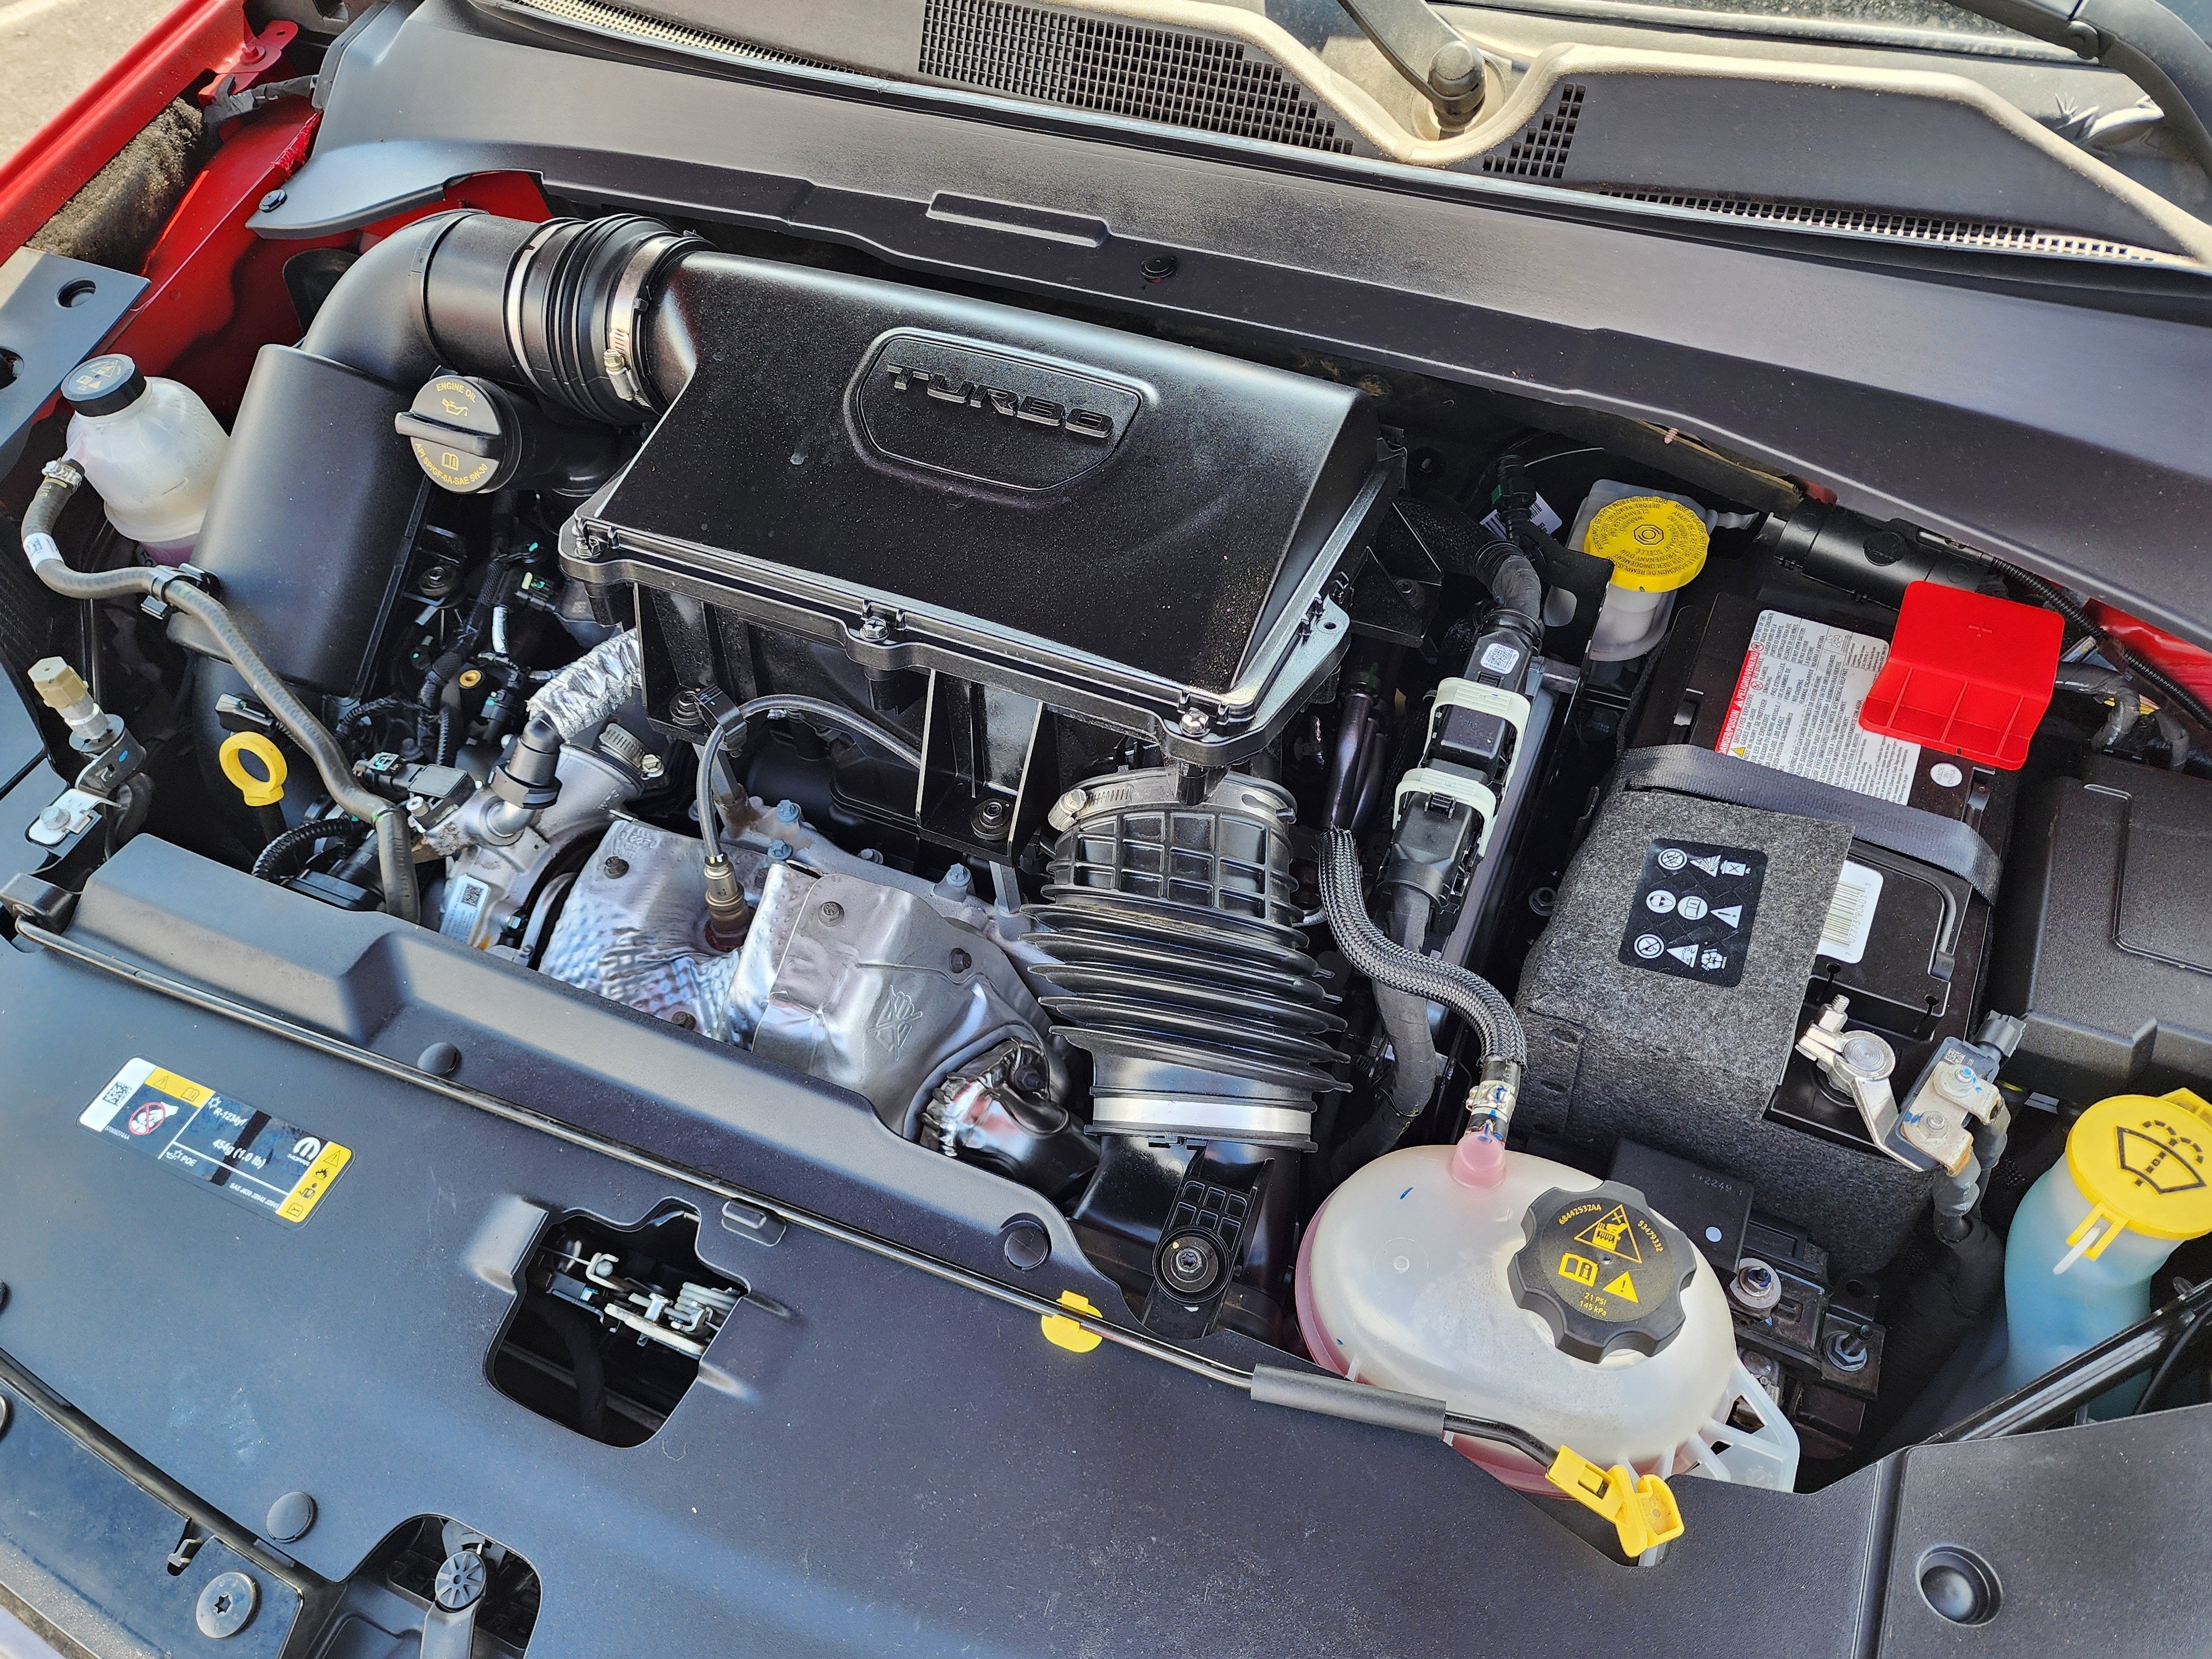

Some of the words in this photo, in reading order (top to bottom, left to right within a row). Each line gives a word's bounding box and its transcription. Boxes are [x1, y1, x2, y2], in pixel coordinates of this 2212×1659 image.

[436, 382, 465, 393] ENGINE
[465, 389, 477, 404] OIL
[887, 362, 1113, 438] TURBO
[415, 443, 425, 458] API
[469, 463, 488, 482] 5W-30
[1610, 499, 1629, 508] FROM
[1673, 503, 1690, 513] MISE
[1593, 509, 1610, 524] SEALED
[1610, 514, 1630, 528] FILLER
[1671, 510, 1691, 524] AVANT
[1600, 523, 1610, 531] USE
[1609, 528, 1618, 537] CAP
[1673, 521, 1687, 539] LIQUIDE
[1600, 534, 1610, 545] ONLY
[1661, 523, 1681, 552] CONTENANT
[1676, 540, 1688, 550] DOT
[1692, 536, 1705, 559] NETTOYER
[1613, 553, 1655, 568] UNIQUEMENT
[1635, 551, 1677, 562] PROVENANT
[1657, 556, 1684, 568] UTILISER
[1657, 562, 1689, 575] BOUCHON
[1735, 651, 1759, 700] PELIGRO/VENENO
[1936, 765, 1944, 781] MADE
[180, 1154, 198, 1167] POE
[213, 1139, 234, 1156] 454g
[232, 1147, 253, 1163] (1.0
[253, 1154, 267, 1170] lb)
[1558, 1203, 1601, 1225] 68442532AA
[1637, 1220, 1663, 1253] 53479332
[1584, 1292, 1593, 1301] 21
[1595, 1296, 1607, 1306] PSI
[1579, 1301, 1592, 1311] 145
[1594, 1306, 1606, 1316] kPa
